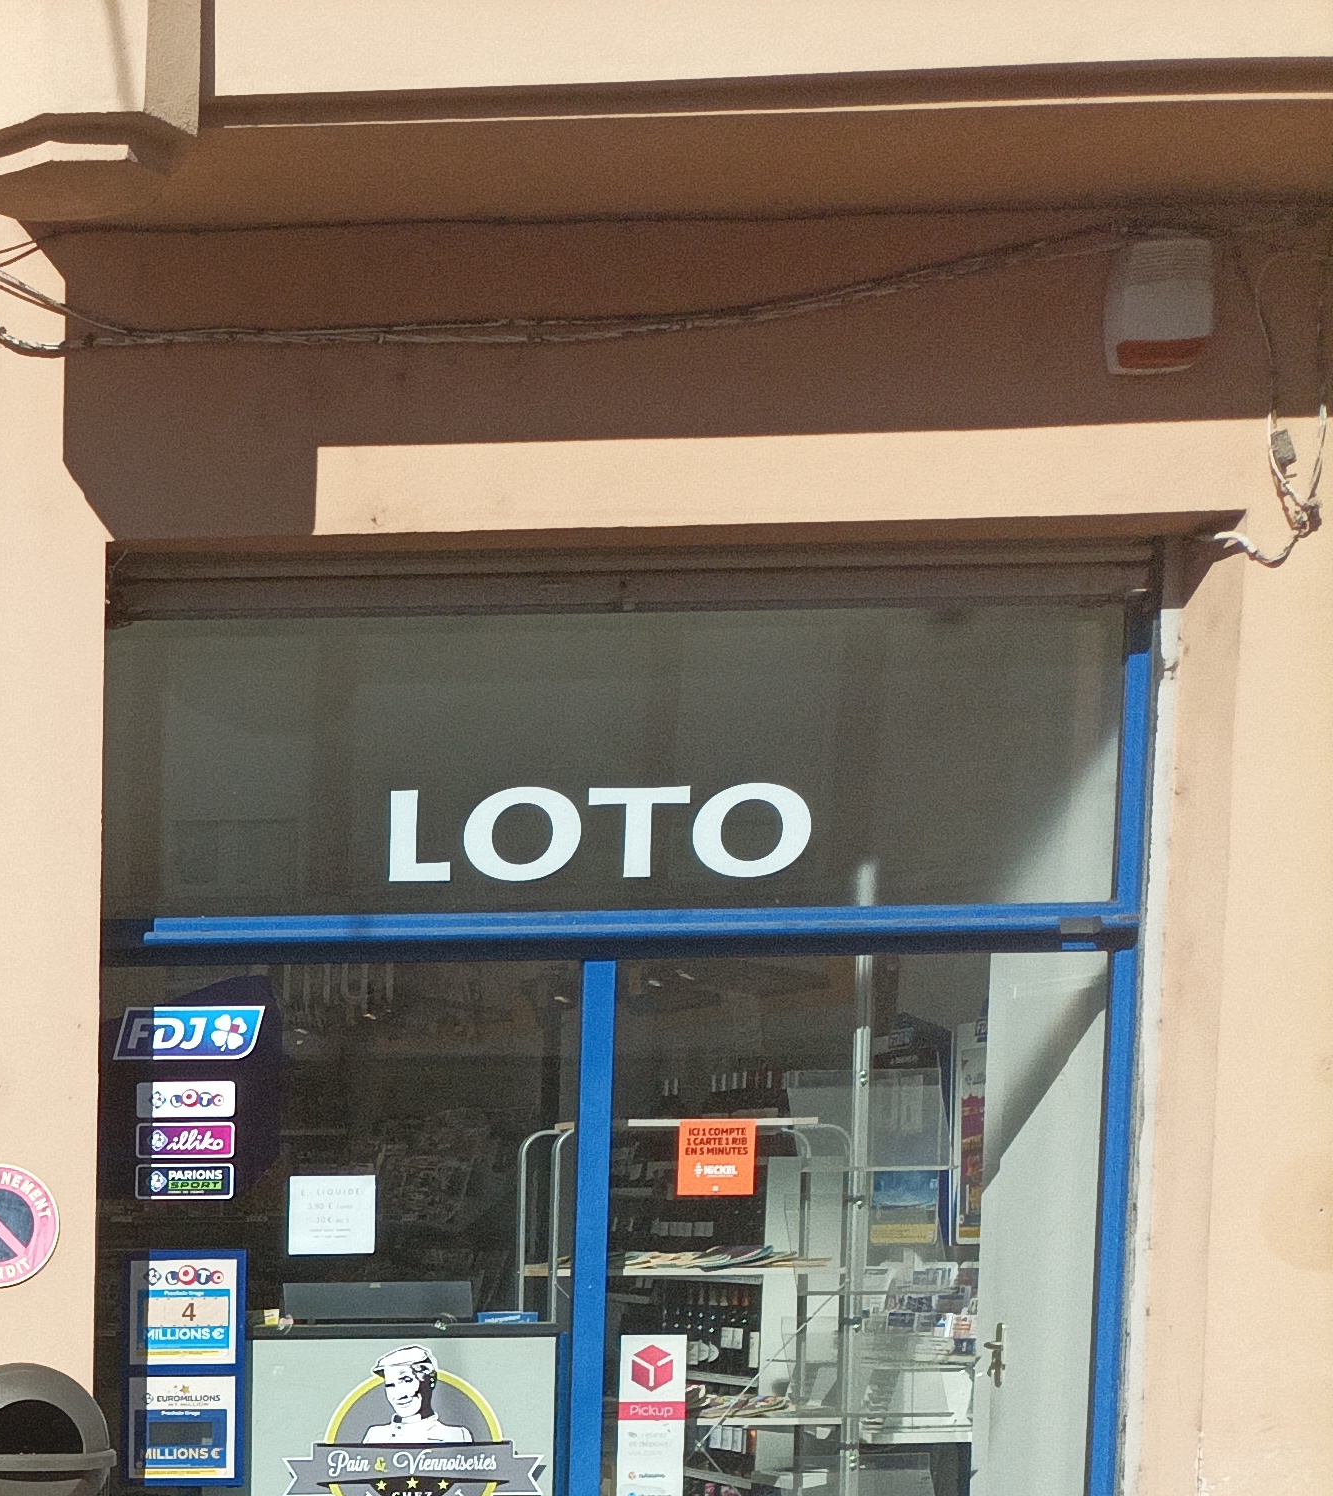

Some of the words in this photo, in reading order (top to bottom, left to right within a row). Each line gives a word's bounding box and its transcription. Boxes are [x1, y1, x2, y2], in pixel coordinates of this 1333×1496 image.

[388, 782, 812, 882] LOTO
[126, 1016, 208, 1051] FDJ
[169, 1088, 225, 1108] LOTO
[688, 1127, 701, 1137] ICI
[701, 1127, 707, 1137] 1
[708, 1127, 747, 1137] COMPTE
[166, 1128, 225, 1151] illiko
[686, 1137, 692, 1146] 1
[693, 1137, 723, 1146] CARTE
[724, 1137, 730, 1146] 1
[731, 1137, 748, 1146] RIB
[684, 1146, 698, 1156] EN
[698, 1146, 705, 1156] 5
[706, 1146, 749, 1156] MINUTES
[167, 1169, 223, 1180] PARIONS
[169, 1181, 221, 1189] SPORT
[164, 1264, 225, 1286] LOTO
[181, 1302, 197, 1322] 4
[211, 1328, 225, 1340] €
[156, 1394, 221, 1402] EUROMILLIONS
[629, 1404, 674, 1418] Pickup
[140, 1447, 209, 1460] MILLIONS
[326, 1449, 370, 1477] Pain
[374, 1456, 388, 1473] &
[391, 1449, 498, 1475] Viennoiseries
